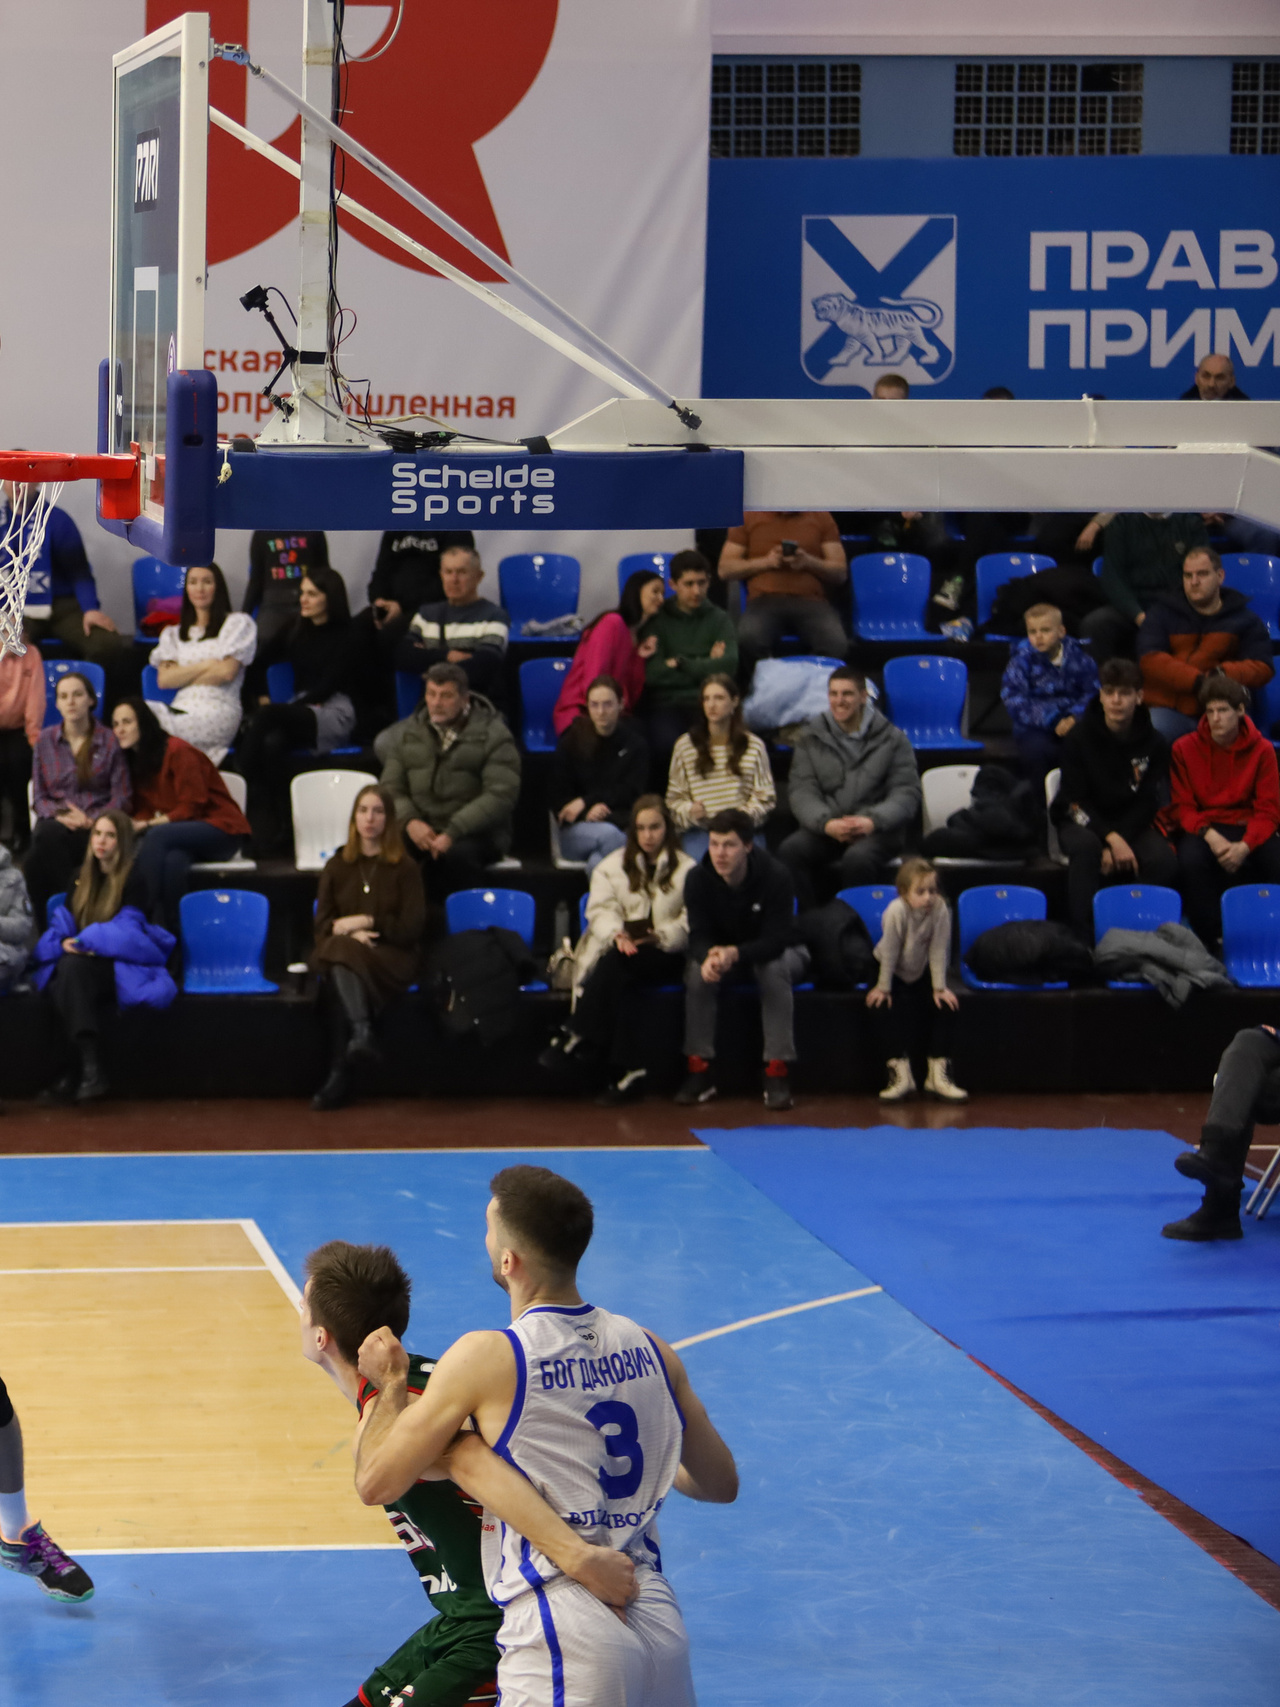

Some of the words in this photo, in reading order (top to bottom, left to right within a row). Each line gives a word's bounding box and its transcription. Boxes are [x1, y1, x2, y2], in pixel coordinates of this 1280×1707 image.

[1029, 229, 1279, 291] ПРАВ
[1028, 308, 1280, 369] ПРИМ
[392, 462, 555, 489] Schelde
[391, 489, 555, 521] Sports
[540, 1346, 658, 1391] БОГДАНОВИЧ
[584, 1400, 644, 1499] 3
